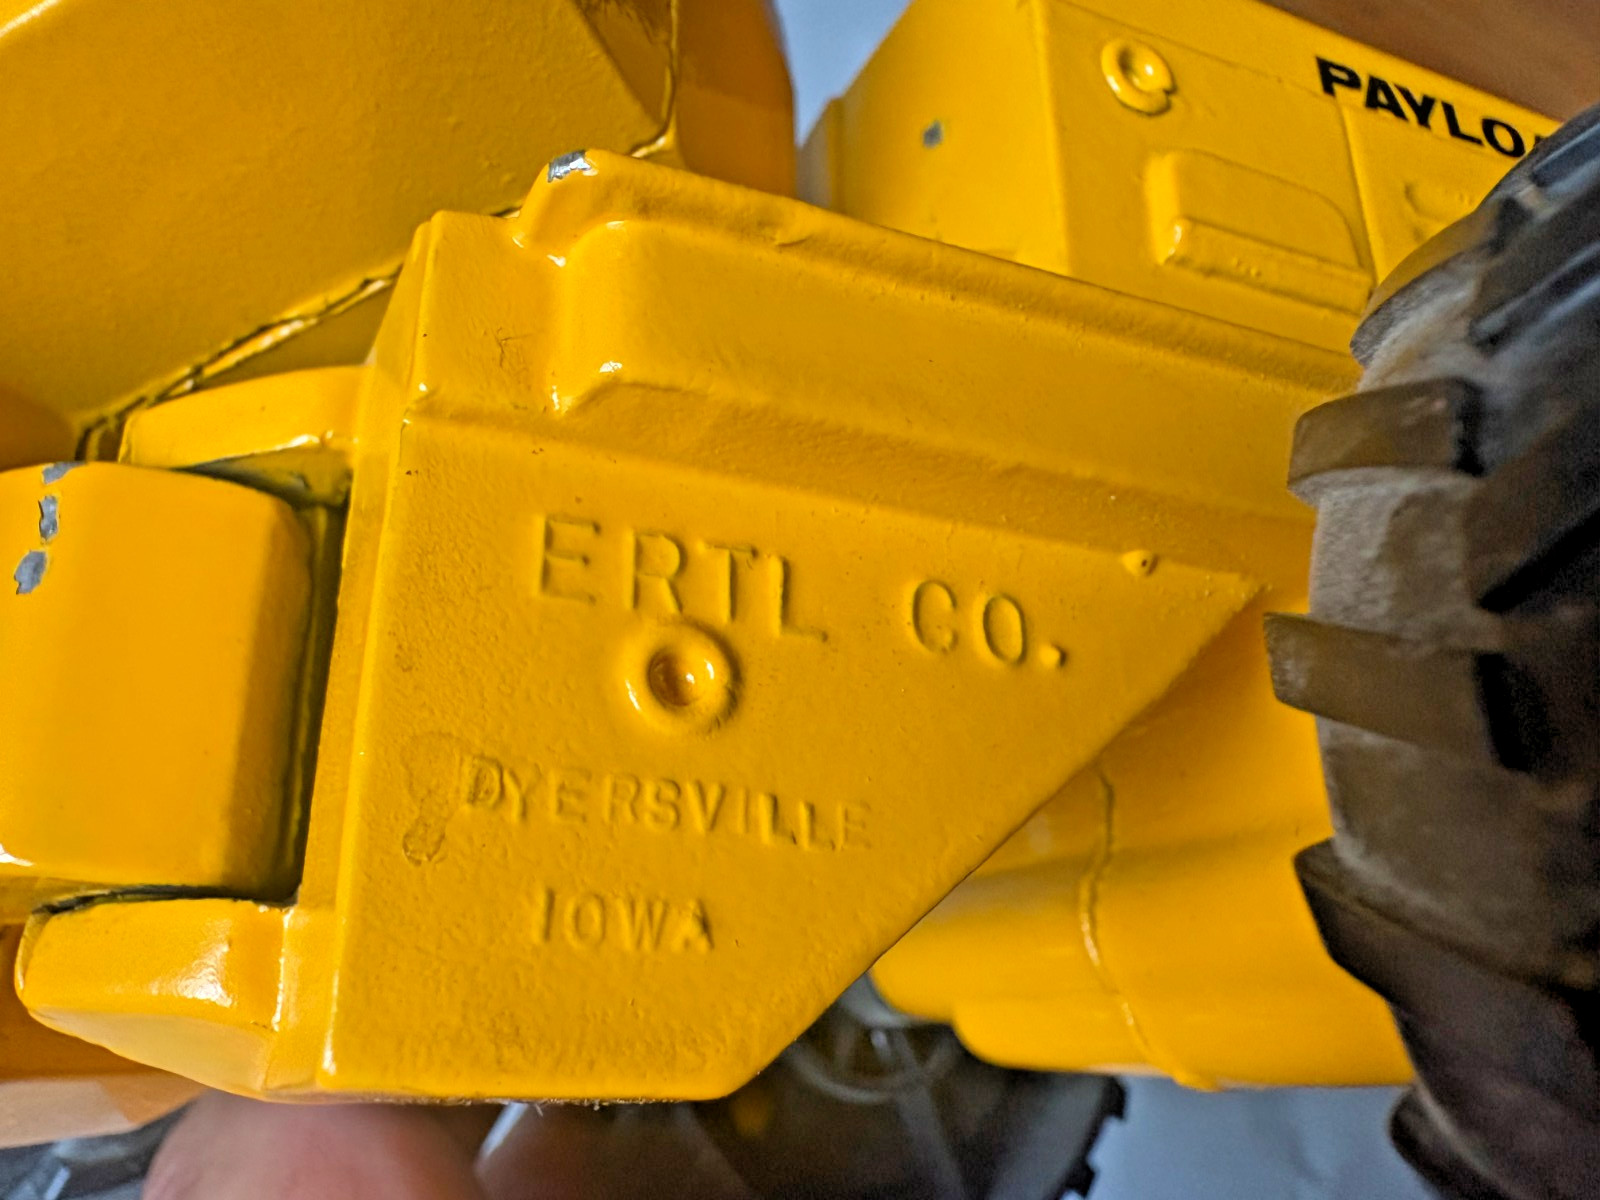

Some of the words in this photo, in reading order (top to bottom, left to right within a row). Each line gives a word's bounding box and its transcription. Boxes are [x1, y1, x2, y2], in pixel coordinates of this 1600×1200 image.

[1315, 55, 1551, 158] PAYLO
[533, 513, 828, 643] ERTL
[909, 577, 1067, 671] CO.
[462, 755, 872, 852] DYERSVILLE
[535, 887, 715, 953] IOWA
